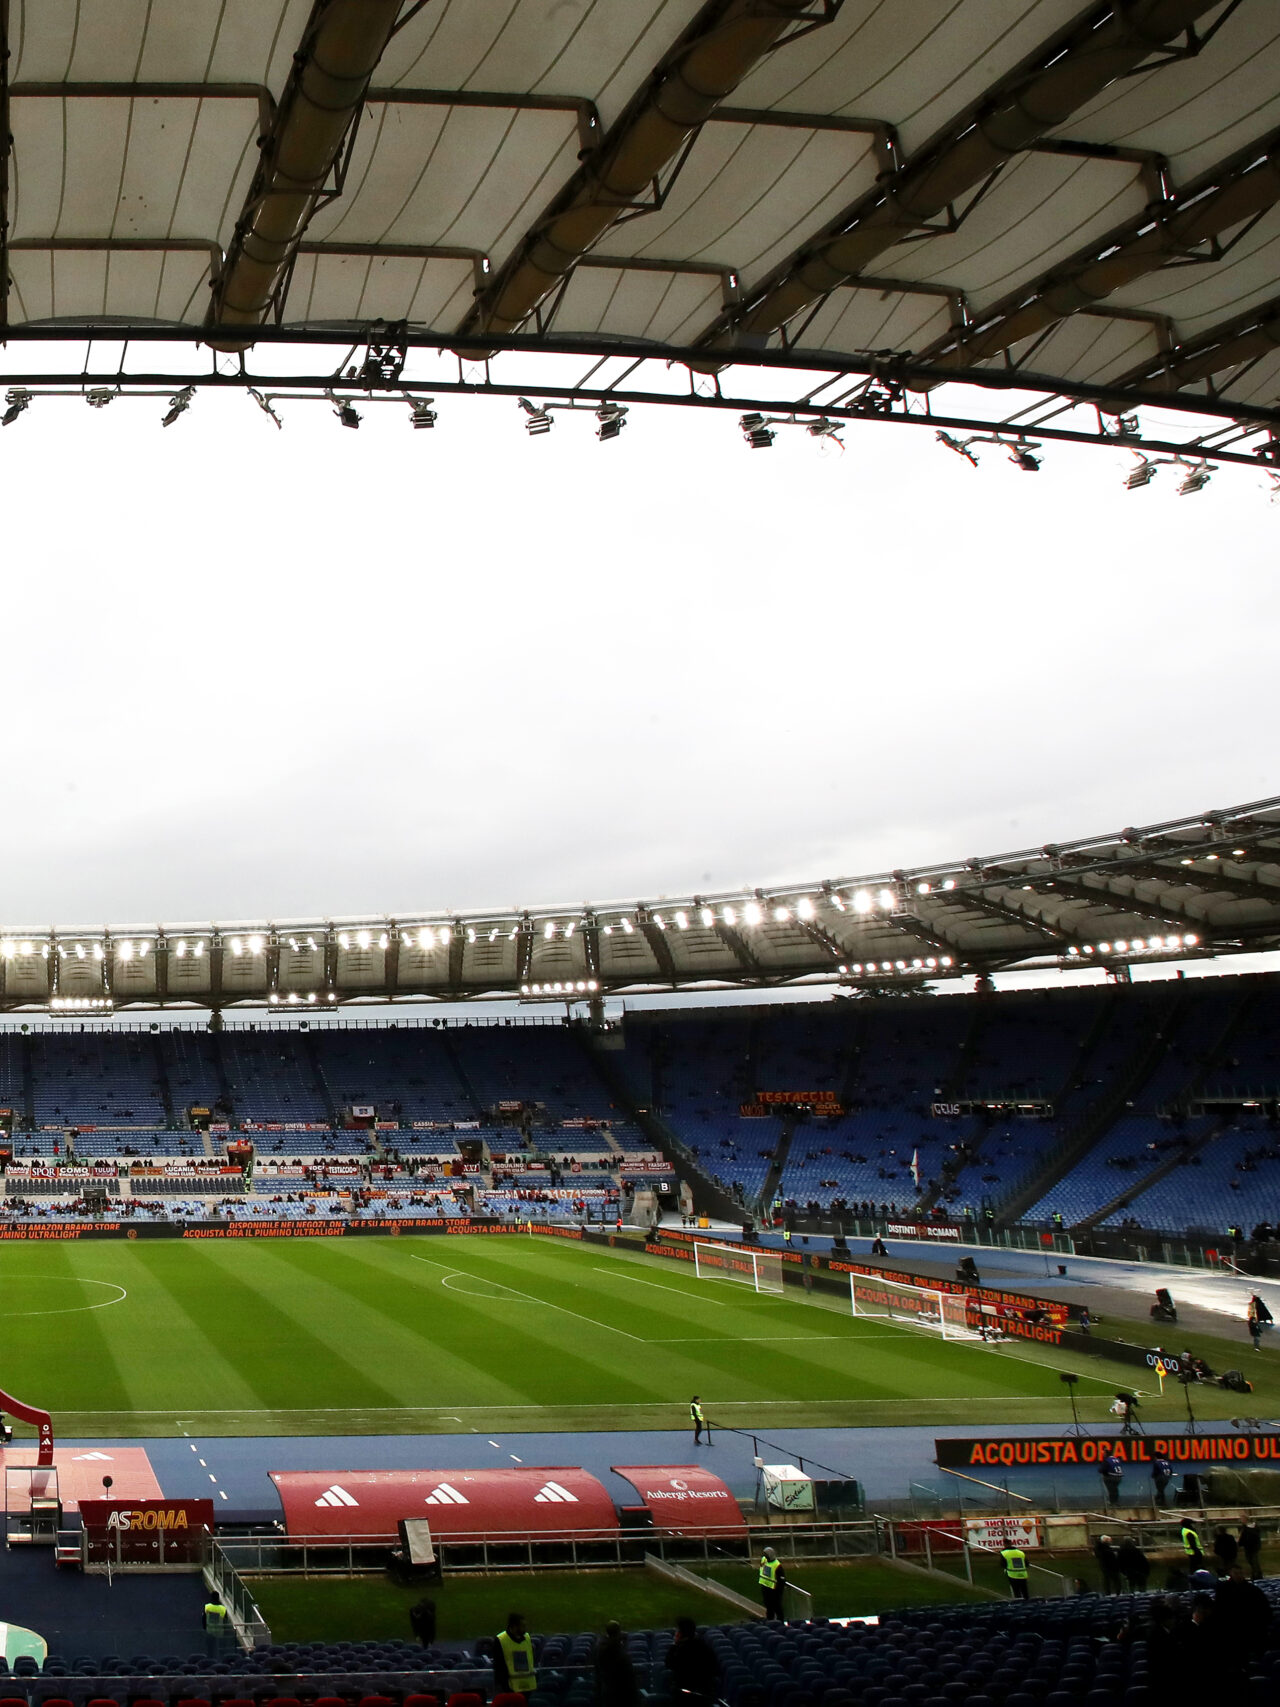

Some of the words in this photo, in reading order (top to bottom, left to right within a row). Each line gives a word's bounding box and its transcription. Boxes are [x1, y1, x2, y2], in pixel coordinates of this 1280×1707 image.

[756, 1091, 835, 1102] TESTACCIO
[31, 1167, 56, 1177] SPQR
[328, 1165, 353, 1174] TESTACCIO
[660, 1182, 669, 1191] B
[183, 1229, 225, 1238] ACQUISTA
[227, 1229, 244, 1237] ORA
[246, 1229, 254, 1237] IL
[255, 1229, 292, 1237] PIUMINO
[293, 1228, 344, 1237] ULTRALIGHT
[447, 1225, 488, 1235] ACQUISTA
[489, 1225, 507, 1233] ORA
[509, 1225, 517, 1233] IL
[887, 1221, 916, 1235] DISTINTI
[28, 1231, 81, 1239] ULTRALIGHT
[828, 1260, 870, 1276] DISPONIBILE
[914, 1276, 943, 1291] ONLINE
[950, 1283, 962, 1295] SU
[1002, 1293, 1036, 1309] BRAND
[855, 1286, 901, 1308] ACQUISTA
[901, 1295, 922, 1312] ORA
[970, 1441, 1079, 1466] ACQUISTA
[1131, 1439, 1151, 1461] IL
[1154, 1437, 1250, 1460] PIUMINO
[1254, 1437, 1280, 1459] UL
[646, 1490, 687, 1501] Auberge
[688, 1490, 728, 1499] Resorts
[784, 1484, 807, 1506] Sixtus
